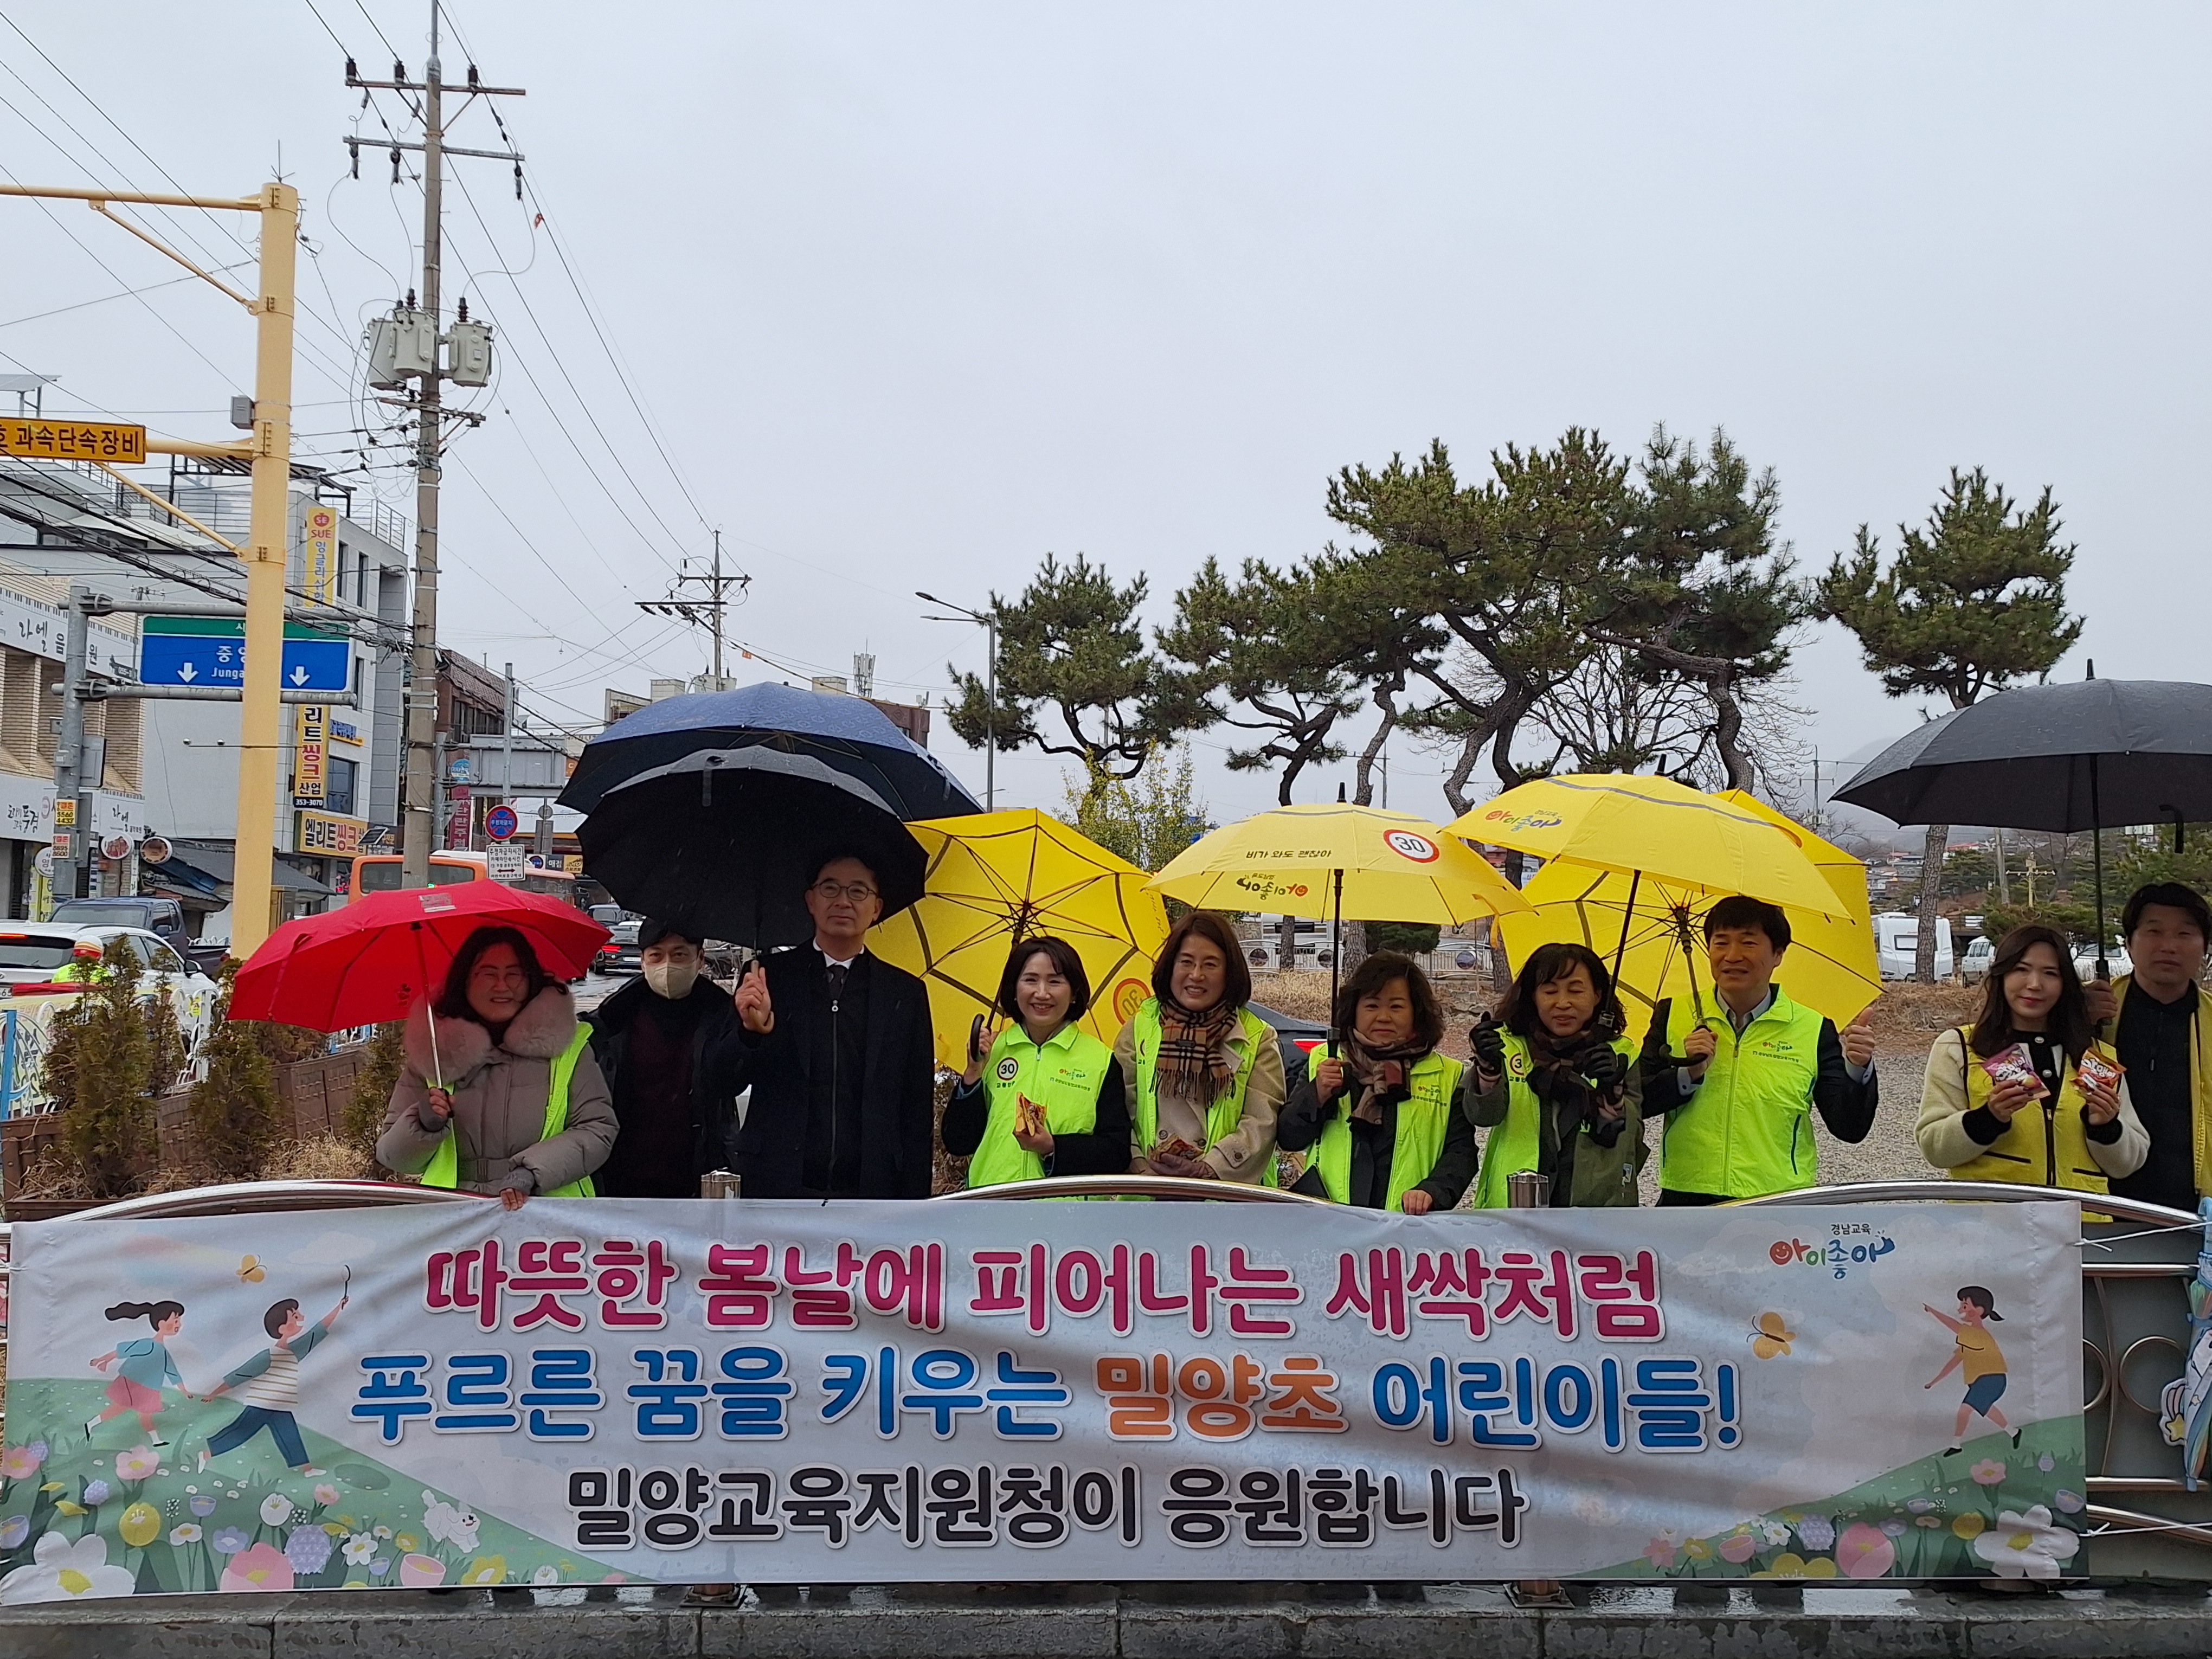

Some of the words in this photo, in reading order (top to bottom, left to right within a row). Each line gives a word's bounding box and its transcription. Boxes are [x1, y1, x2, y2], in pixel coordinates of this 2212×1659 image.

[15, 425, 138, 456] 과속단속장비
[311, 530, 331, 538] SUE
[211, 667, 245, 680] Junga
[301, 707, 323, 781] 리트씽크
[299, 782, 321, 795] 산업
[295, 799, 323, 807] 353-3070
[1486, 810, 1562, 832] 아이좋아
[305, 818, 357, 852] 엘리트씽크
[1395, 837, 1426, 853] 30
[1246, 850, 1269, 859] 비가
[1271, 850, 1295, 858] 와도
[1000, 1063, 1015, 1075] 30
[1514, 1058, 1522, 1069] 3
[1830, 1224, 1872, 1235] 경남교육
[1769, 1238, 1895, 1279] 아이좋아
[426, 1239, 676, 1328] 따뜻한
[698, 1242, 942, 1330] 봄날에
[969, 1243, 1300, 1334] 피어나는
[1326, 1247, 1661, 1338] 새싹처럼
[351, 1349, 601, 1441] 푸르른
[627, 1346, 792, 1436] 꿈을
[821, 1346, 1068, 1436] 키우는
[1096, 1353, 1345, 1438] 밀양초
[1372, 1356, 1737, 1448] 어린이들!
[568, 1465, 1143, 1548] 밀양교육지원청이
[1162, 1468, 1532, 1550] 응원합니다
